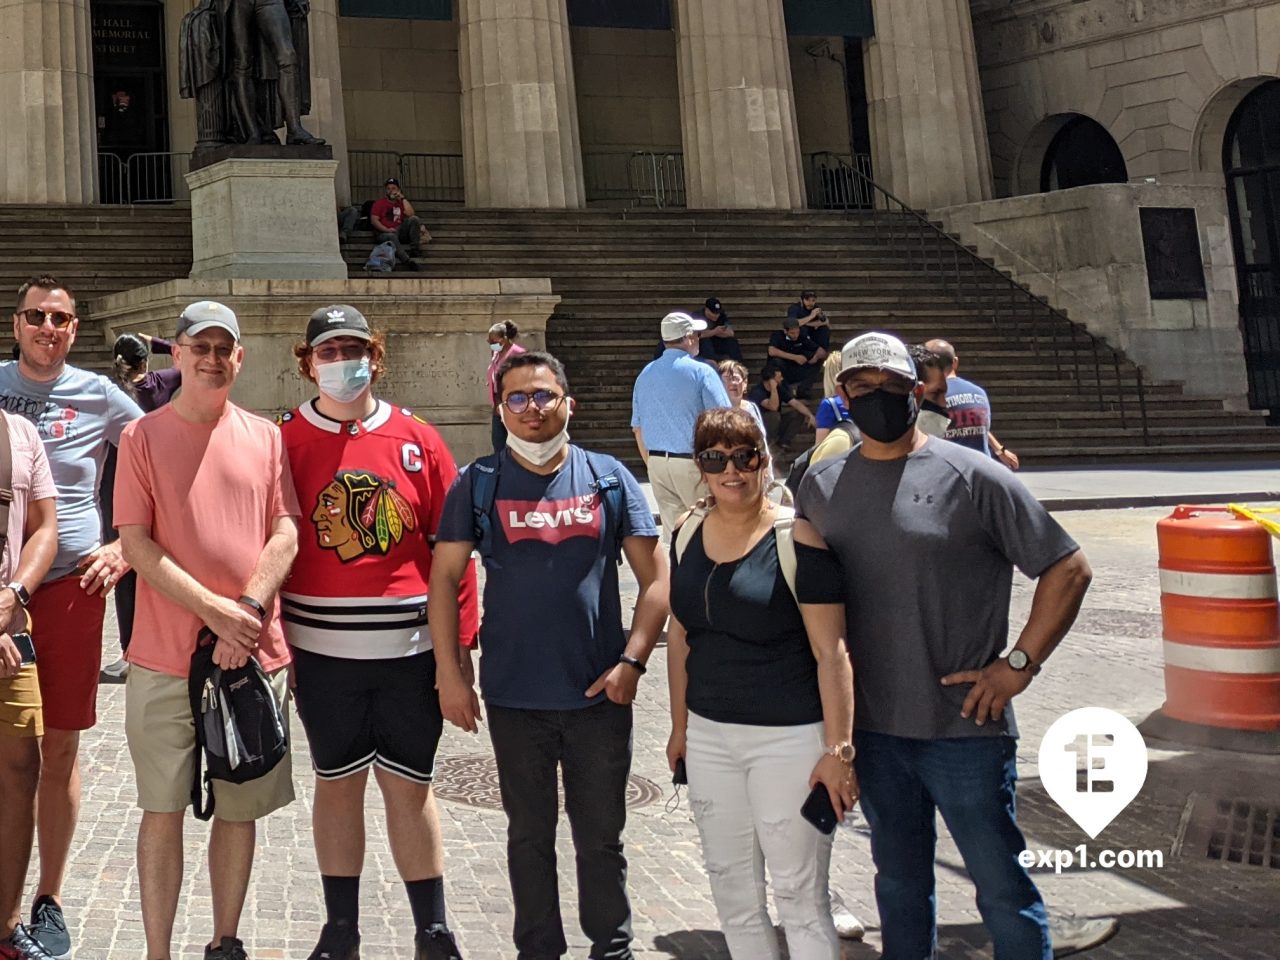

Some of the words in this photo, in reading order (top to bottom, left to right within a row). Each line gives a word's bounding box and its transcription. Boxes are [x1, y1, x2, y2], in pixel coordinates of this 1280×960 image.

[853, 349, 868, 358] NEW
[871, 348, 892, 356] YORK
[401, 443, 422, 472] C
